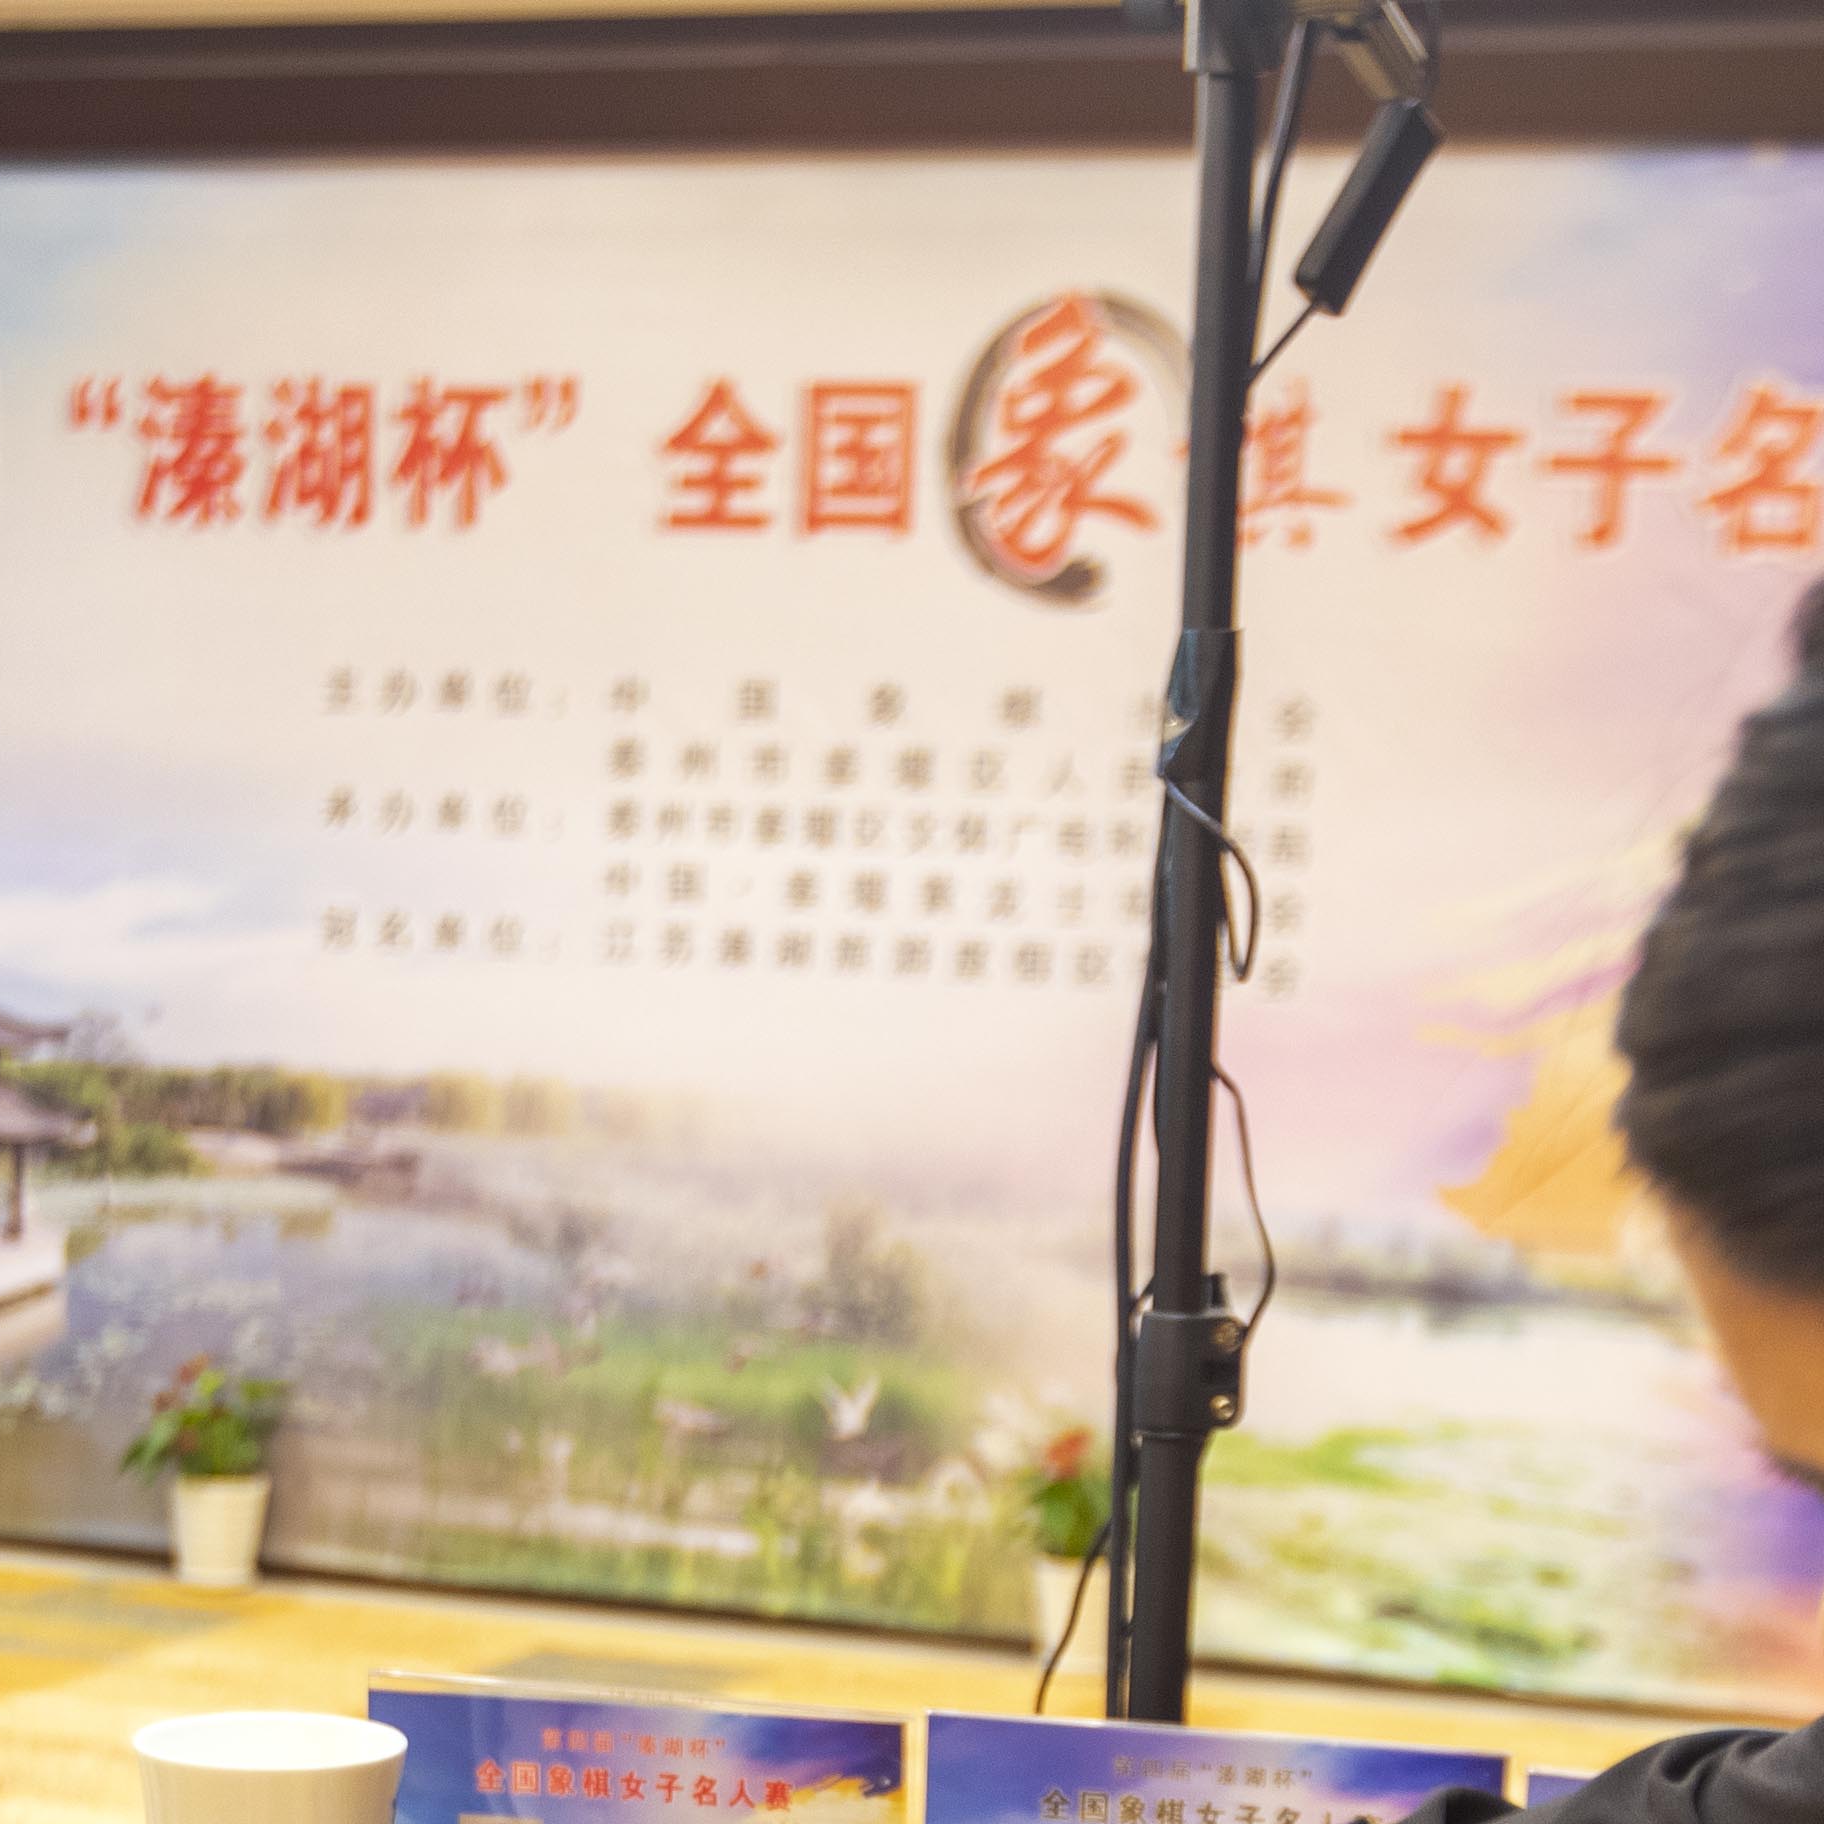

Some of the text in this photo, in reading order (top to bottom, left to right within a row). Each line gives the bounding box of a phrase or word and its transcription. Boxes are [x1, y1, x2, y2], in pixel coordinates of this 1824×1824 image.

[477, 1759, 793, 1812] 全国象棋女子名人赛
